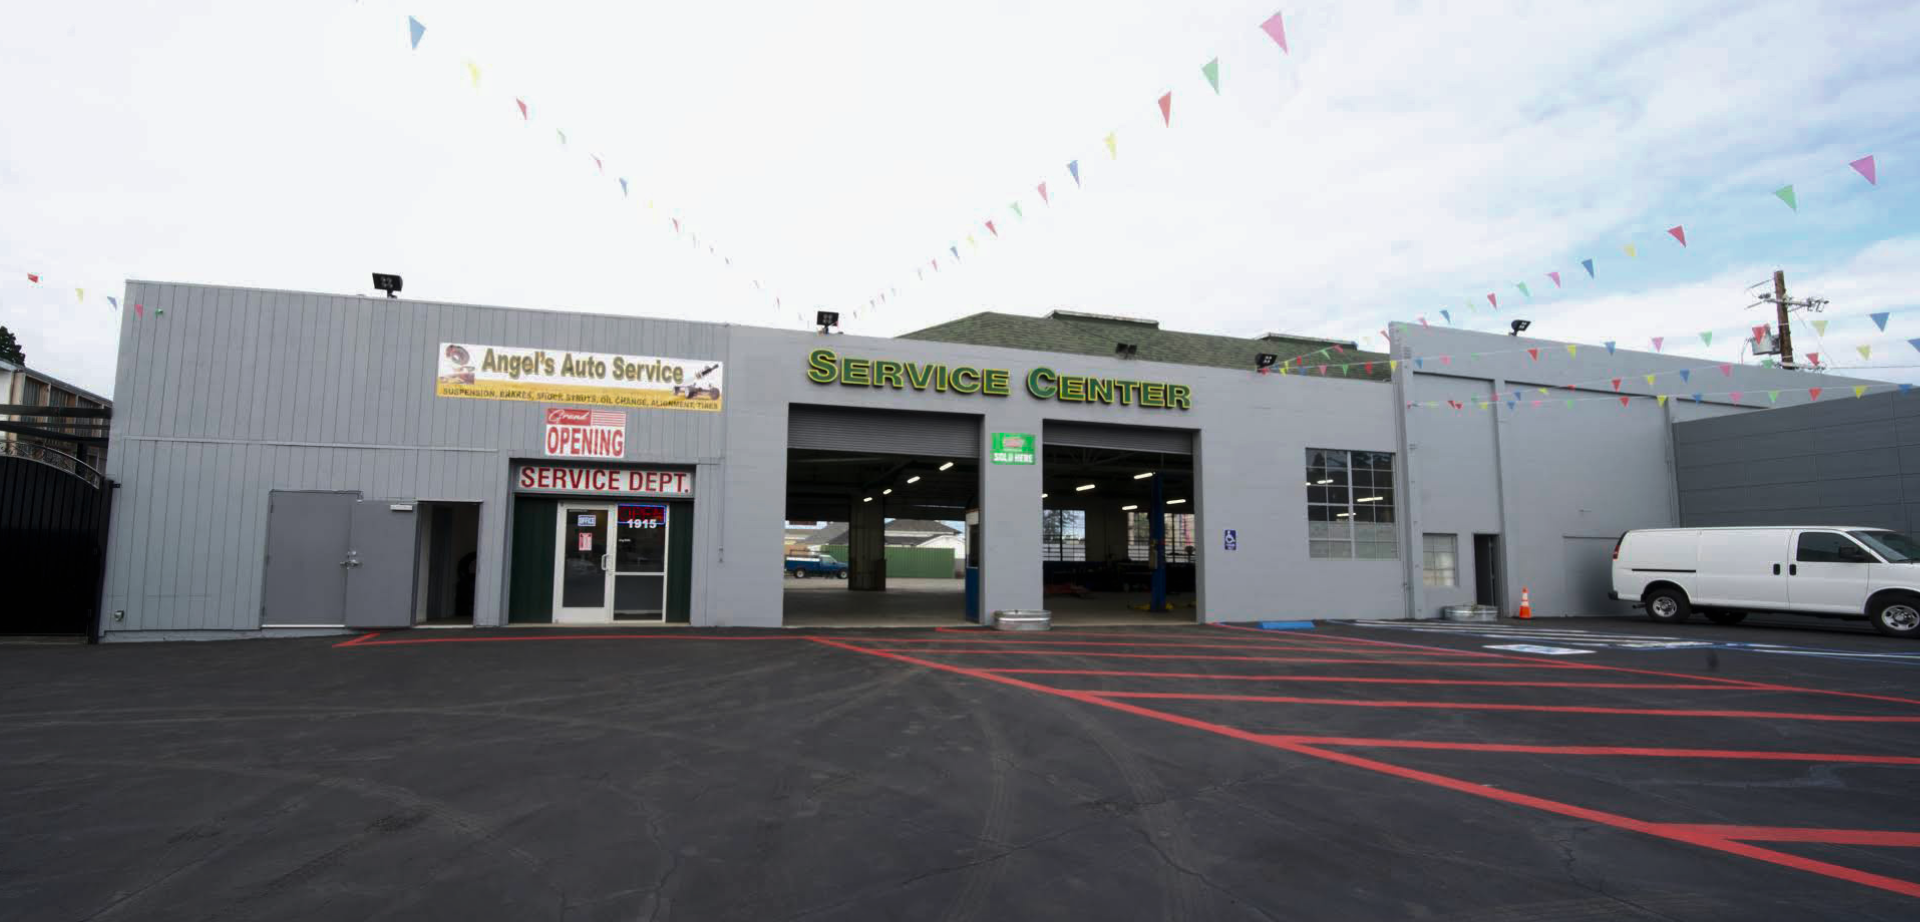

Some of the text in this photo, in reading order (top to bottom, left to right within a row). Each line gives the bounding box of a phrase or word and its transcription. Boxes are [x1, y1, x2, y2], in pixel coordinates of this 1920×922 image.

[481, 348, 684, 384] Angel's Auto Service
[806, 348, 1192, 410] SERVICE CENTER
[549, 409, 590, 424] Grand
[547, 426, 623, 457] OPENING
[521, 466, 689, 493] SERVICE DEPT.
[627, 519, 657, 529] 1915
